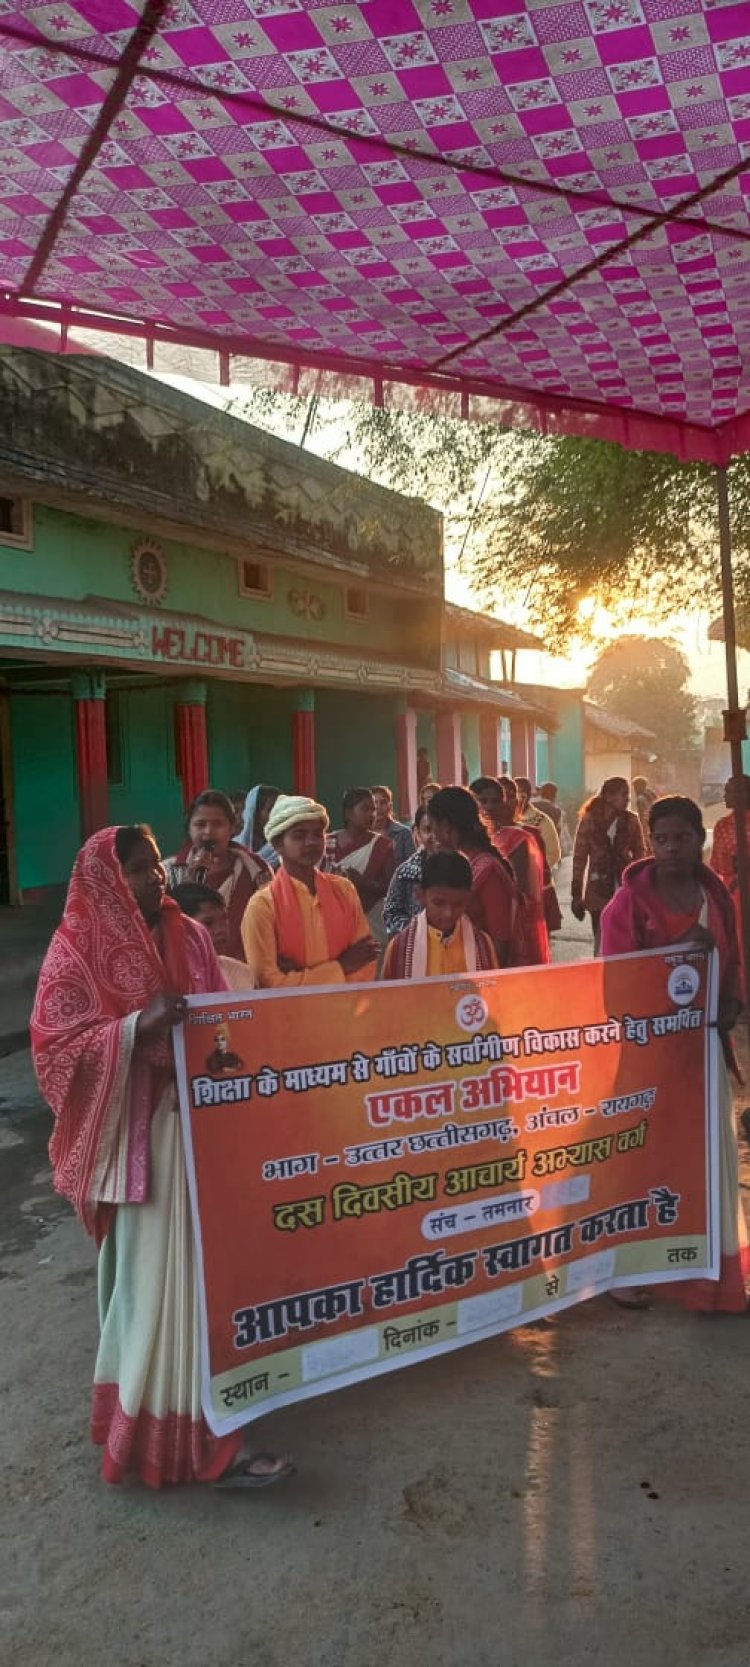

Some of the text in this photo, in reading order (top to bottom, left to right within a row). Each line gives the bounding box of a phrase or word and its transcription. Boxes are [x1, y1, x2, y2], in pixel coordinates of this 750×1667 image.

[152, 625, 245, 667] WELCOME
[192, 1075, 252, 1107] शिक्षा
[257, 1066, 278, 1096] के
[283, 1061, 348, 1093] माध्यम
[352, 1051, 370, 1082] से
[422, 1041, 442, 1070] के
[523, 1028, 580, 1056] विकास
[584, 1016, 622, 1046] करने
[625, 1016, 650, 1045] हेतु
[652, 1009, 703, 1036] समर्पित
[366, 1061, 581, 1127] एकल अभियान
[263, 1153, 319, 1180] भाग
[345, 1138, 404, 1165] उत्तर
[526, 1106, 580, 1132] अंचल
[273, 1196, 325, 1232] दस
[331, 1173, 437, 1220] दिवसीय
[443, 1149, 527, 1196] आचार्य
[533, 1136, 611, 1175] अभ्यास
[615, 1120, 648, 1153] वर्ग
[429, 1211, 459, 1235] संच
[482, 1195, 535, 1221] तमनार
[233, 1279, 365, 1350] आपका
[370, 1250, 477, 1309] हार्दिक
[482, 1223, 574, 1278] स्वागत
[579, 1200, 652, 1244] करता
[648, 1186, 680, 1227] है
[219, 1372, 270, 1407] स्थान
[383, 1319, 441, 1353] दिनांक
[545, 1273, 561, 1297] से
[667, 1246, 698, 1264] तक
